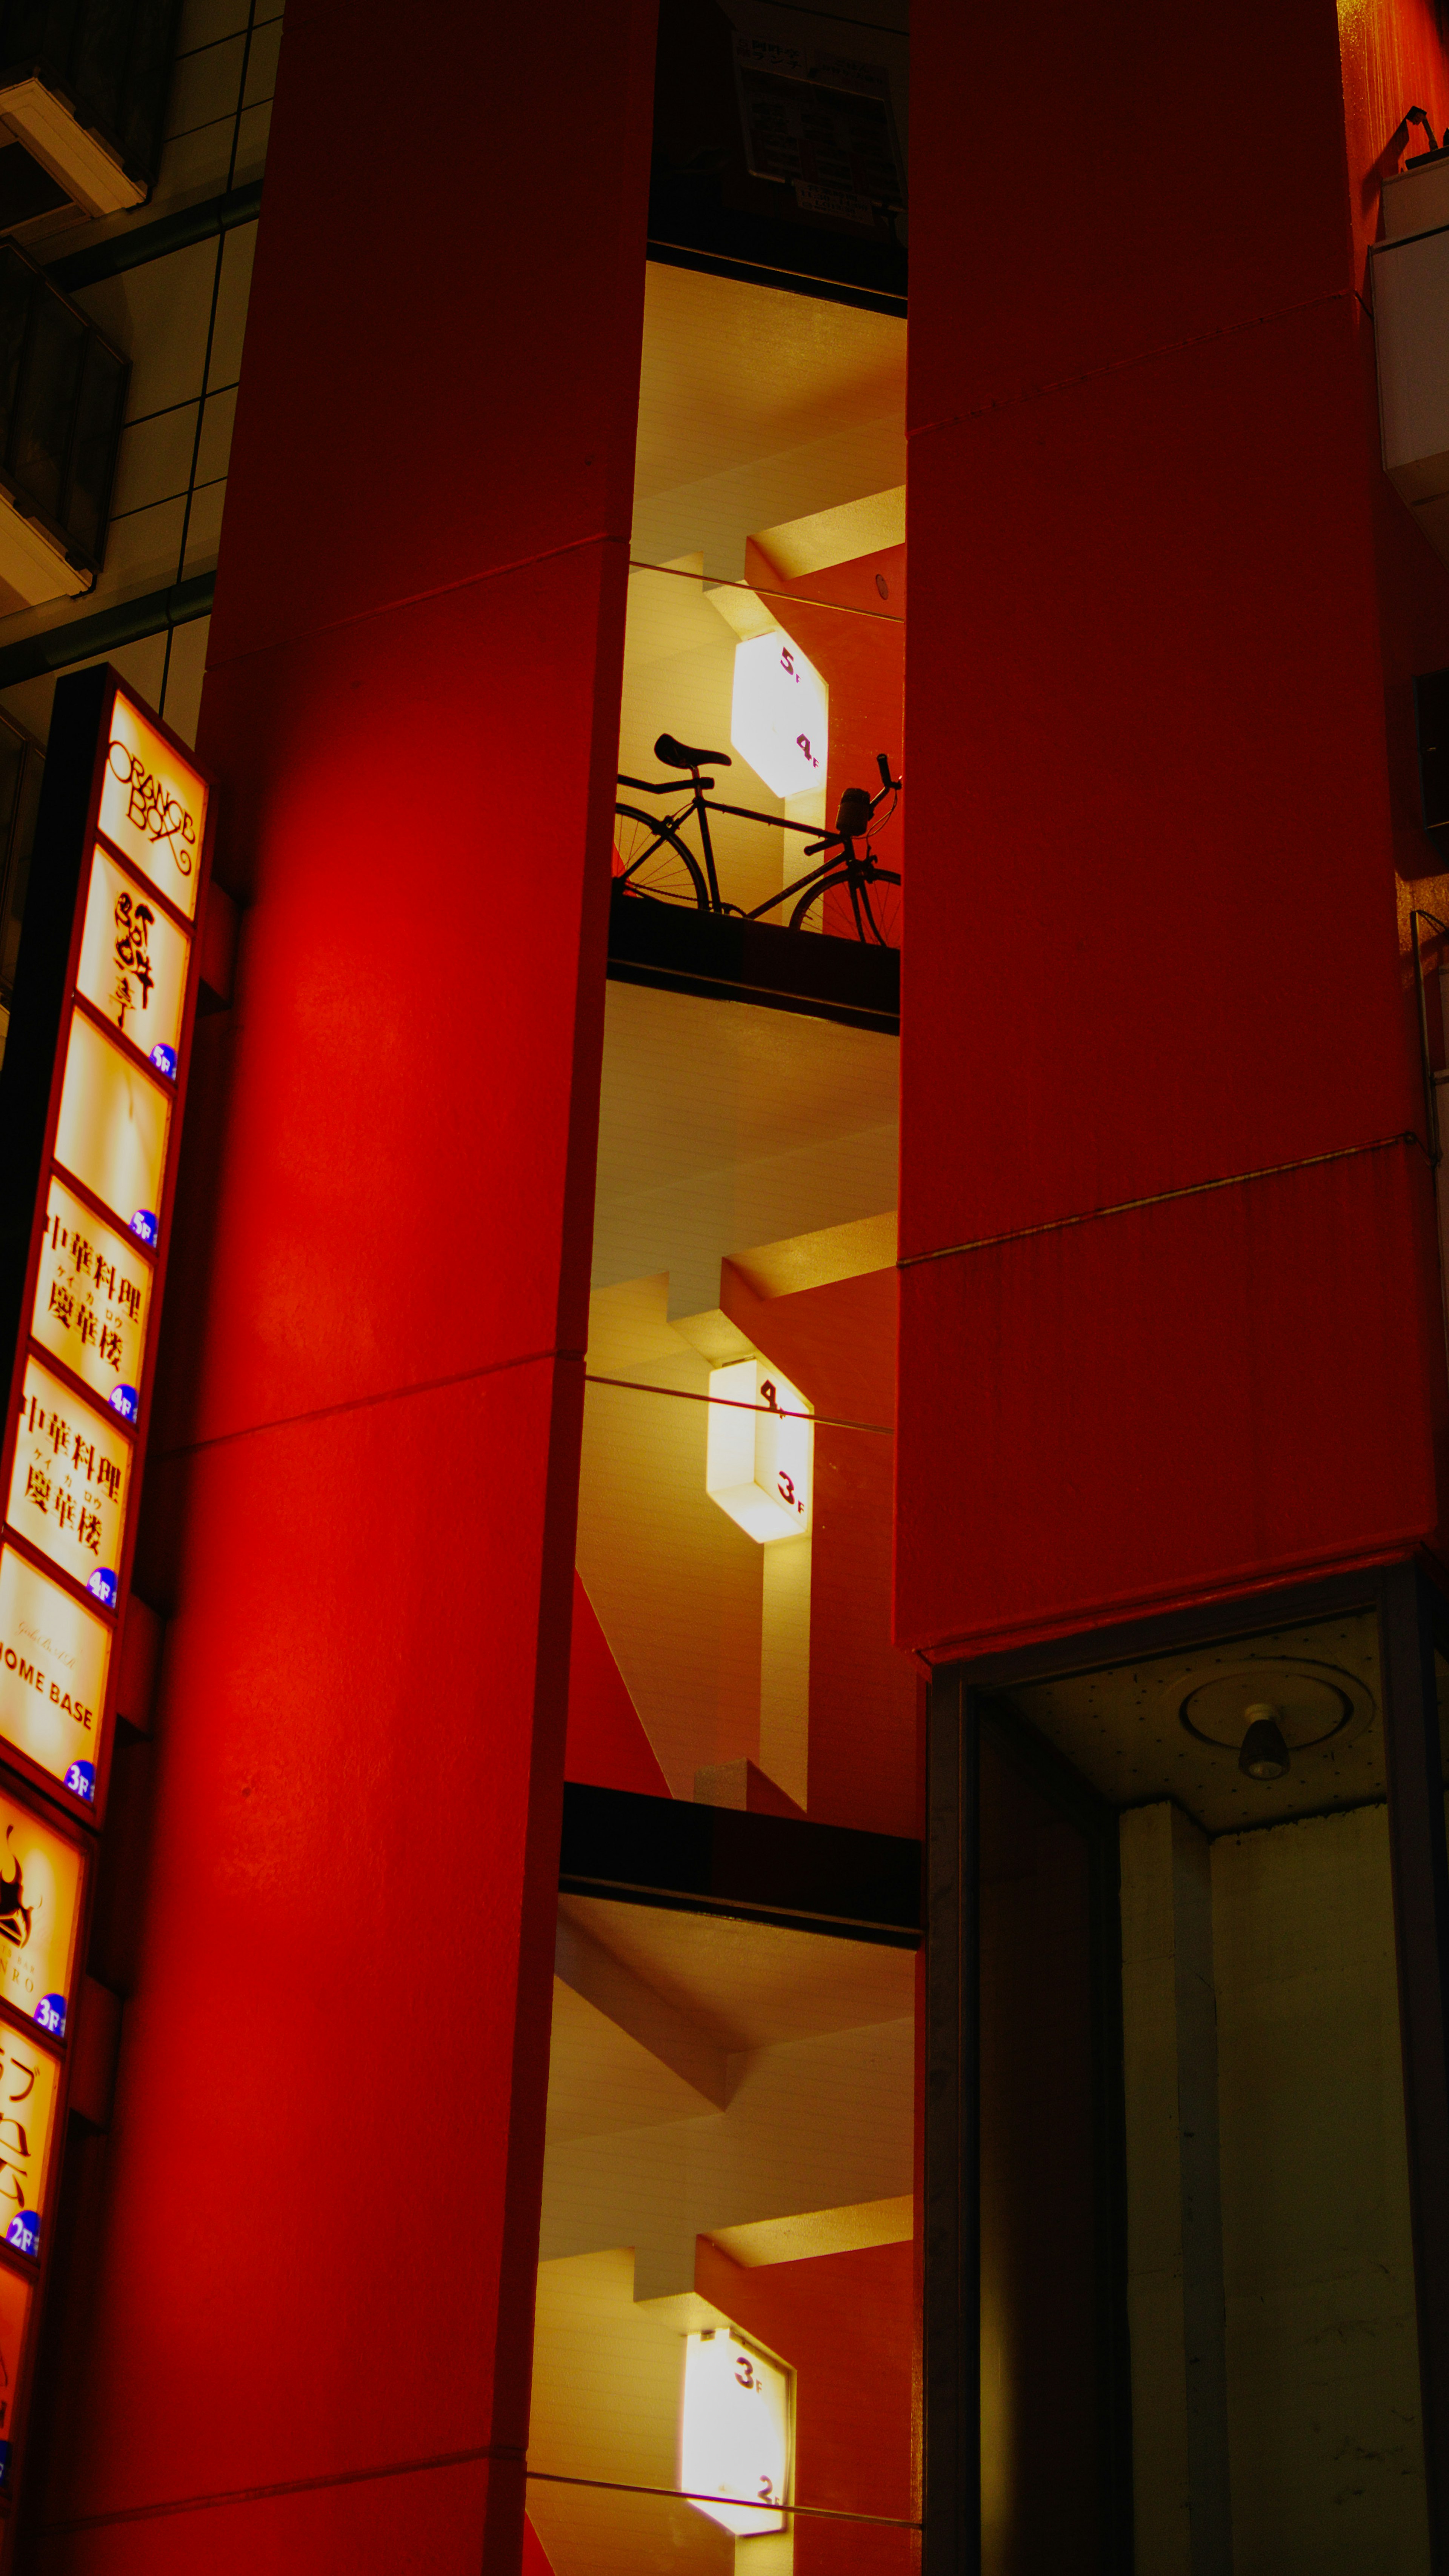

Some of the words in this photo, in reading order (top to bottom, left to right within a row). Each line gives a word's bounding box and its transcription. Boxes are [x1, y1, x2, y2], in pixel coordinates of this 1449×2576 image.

[780, 646, 801, 684] 5F
[109, 741, 195, 845] ORANGE
[126, 788, 192, 876] BOX
[154, 1045, 170, 1072] 5F
[132, 1211, 151, 1239] 5F
[45, 1216, 141, 1324] 中華料理
[48, 1280, 123, 1373] 慶華楼
[111, 1388, 132, 1416] 4F
[23, 1395, 121, 1505] 中華料理
[24, 1463, 102, 1556] 慶華楼
[778, 1470, 804, 1514] 3F
[89, 1571, 110, 1601] 4F
[49, 1682, 93, 1731] BASE
[67, 1764, 89, 1797] 3F
[37, 1998, 60, 2032] 3F
[11, 2217, 32, 2252] 2F
[734, 2356, 762, 2394] 3F
